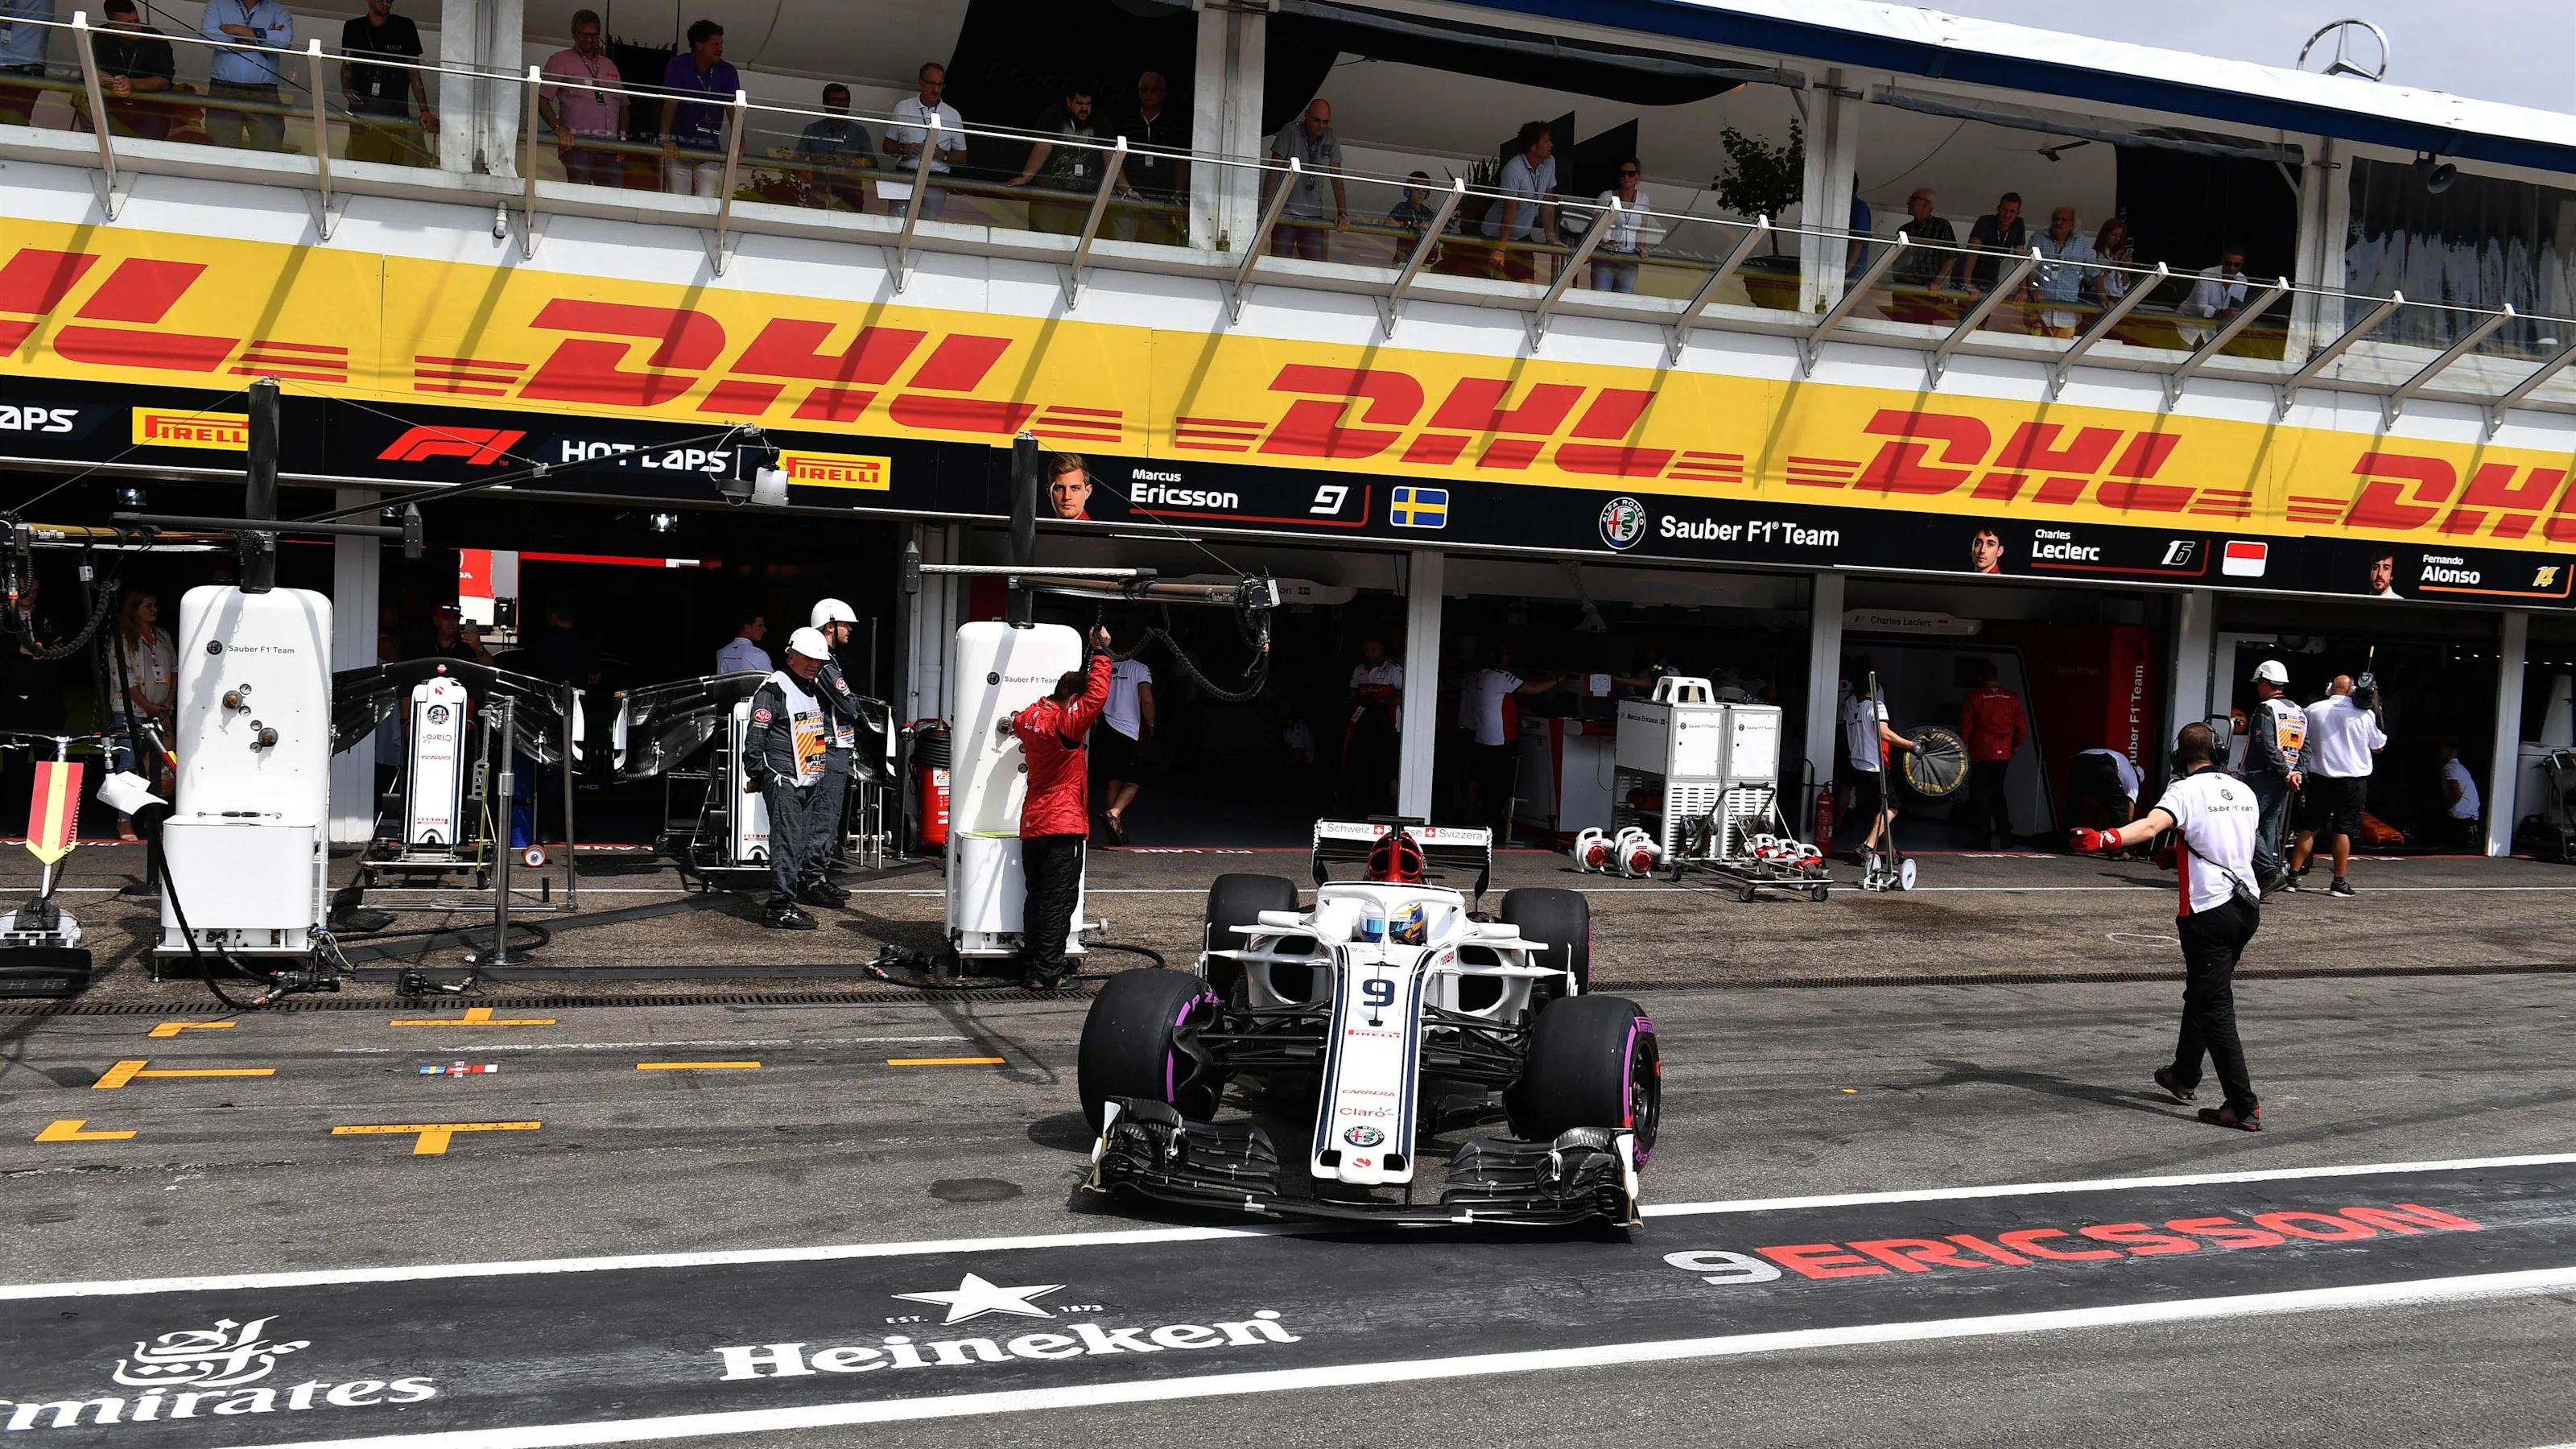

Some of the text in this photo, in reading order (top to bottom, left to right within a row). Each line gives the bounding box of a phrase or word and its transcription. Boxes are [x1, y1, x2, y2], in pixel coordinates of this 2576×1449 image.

[517, 298, 1038, 435] DHL
[145, 415, 248, 444] PIRELL
[1257, 364, 1675, 477] DHL
[562, 440, 637, 466] HOT
[1854, 409, 2196, 511] DHL
[786, 456, 881, 483] PIRELLI
[1132, 469, 1182, 482] Marcus
[1129, 483, 1349, 514] Ericsson 9
[1602, 499, 1644, 525] ALFA ROMEO
[1660, 515, 1742, 541] Sauber
[1782, 523, 1839, 547] Team
[2035, 528, 2071, 540] Charles
[2032, 540, 2196, 565] Leclerc 16
[2422, 554, 2464, 565] Fernando
[2421, 565, 2561, 588] Alonso 14
[1871, 616, 1901, 625] Charles
[1903, 617, 1932, 626] Leclerc
[228, 645, 258, 653] Sauber
[2131, 665, 2144, 702] Team
[426, 733, 452, 742] Claro
[2128, 727, 2139, 767] auber
[1327, 824, 1370, 834] Schweiz
[1439, 828, 1483, 840] Svizzera
[1362, 979, 1395, 1007] 9
[1348, 1030, 1401, 1038] PIRELLI
[1340, 1107, 1385, 1117] Claro
[886, 1315, 928, 1324] EST.
[713, 1309, 1301, 1382] Heineken
[0, 1375, 438, 1430] mirates
